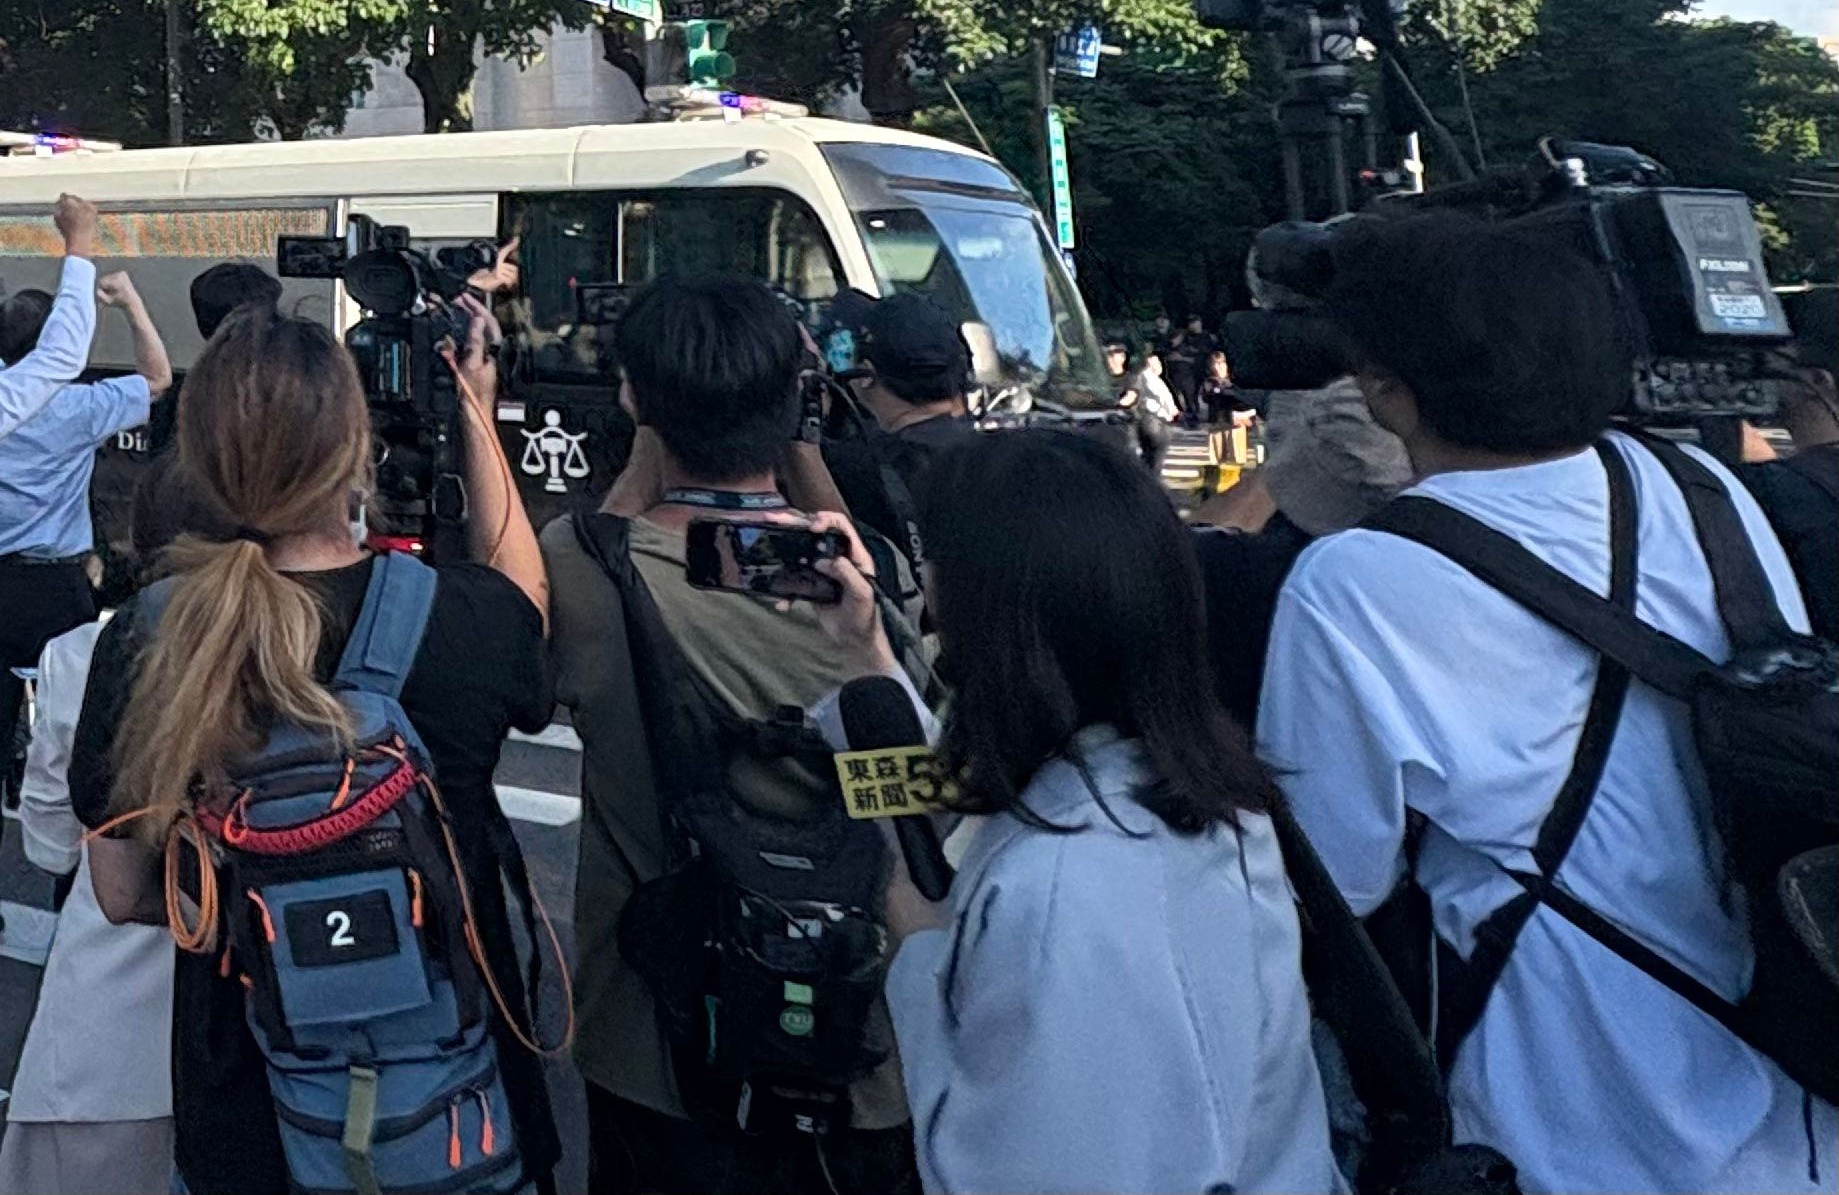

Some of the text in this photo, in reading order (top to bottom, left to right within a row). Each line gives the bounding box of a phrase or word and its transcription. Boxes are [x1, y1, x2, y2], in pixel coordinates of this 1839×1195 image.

[844, 756, 901, 782] 東森
[852, 782, 909, 812] 新聞
[325, 910, 356, 948] 2
